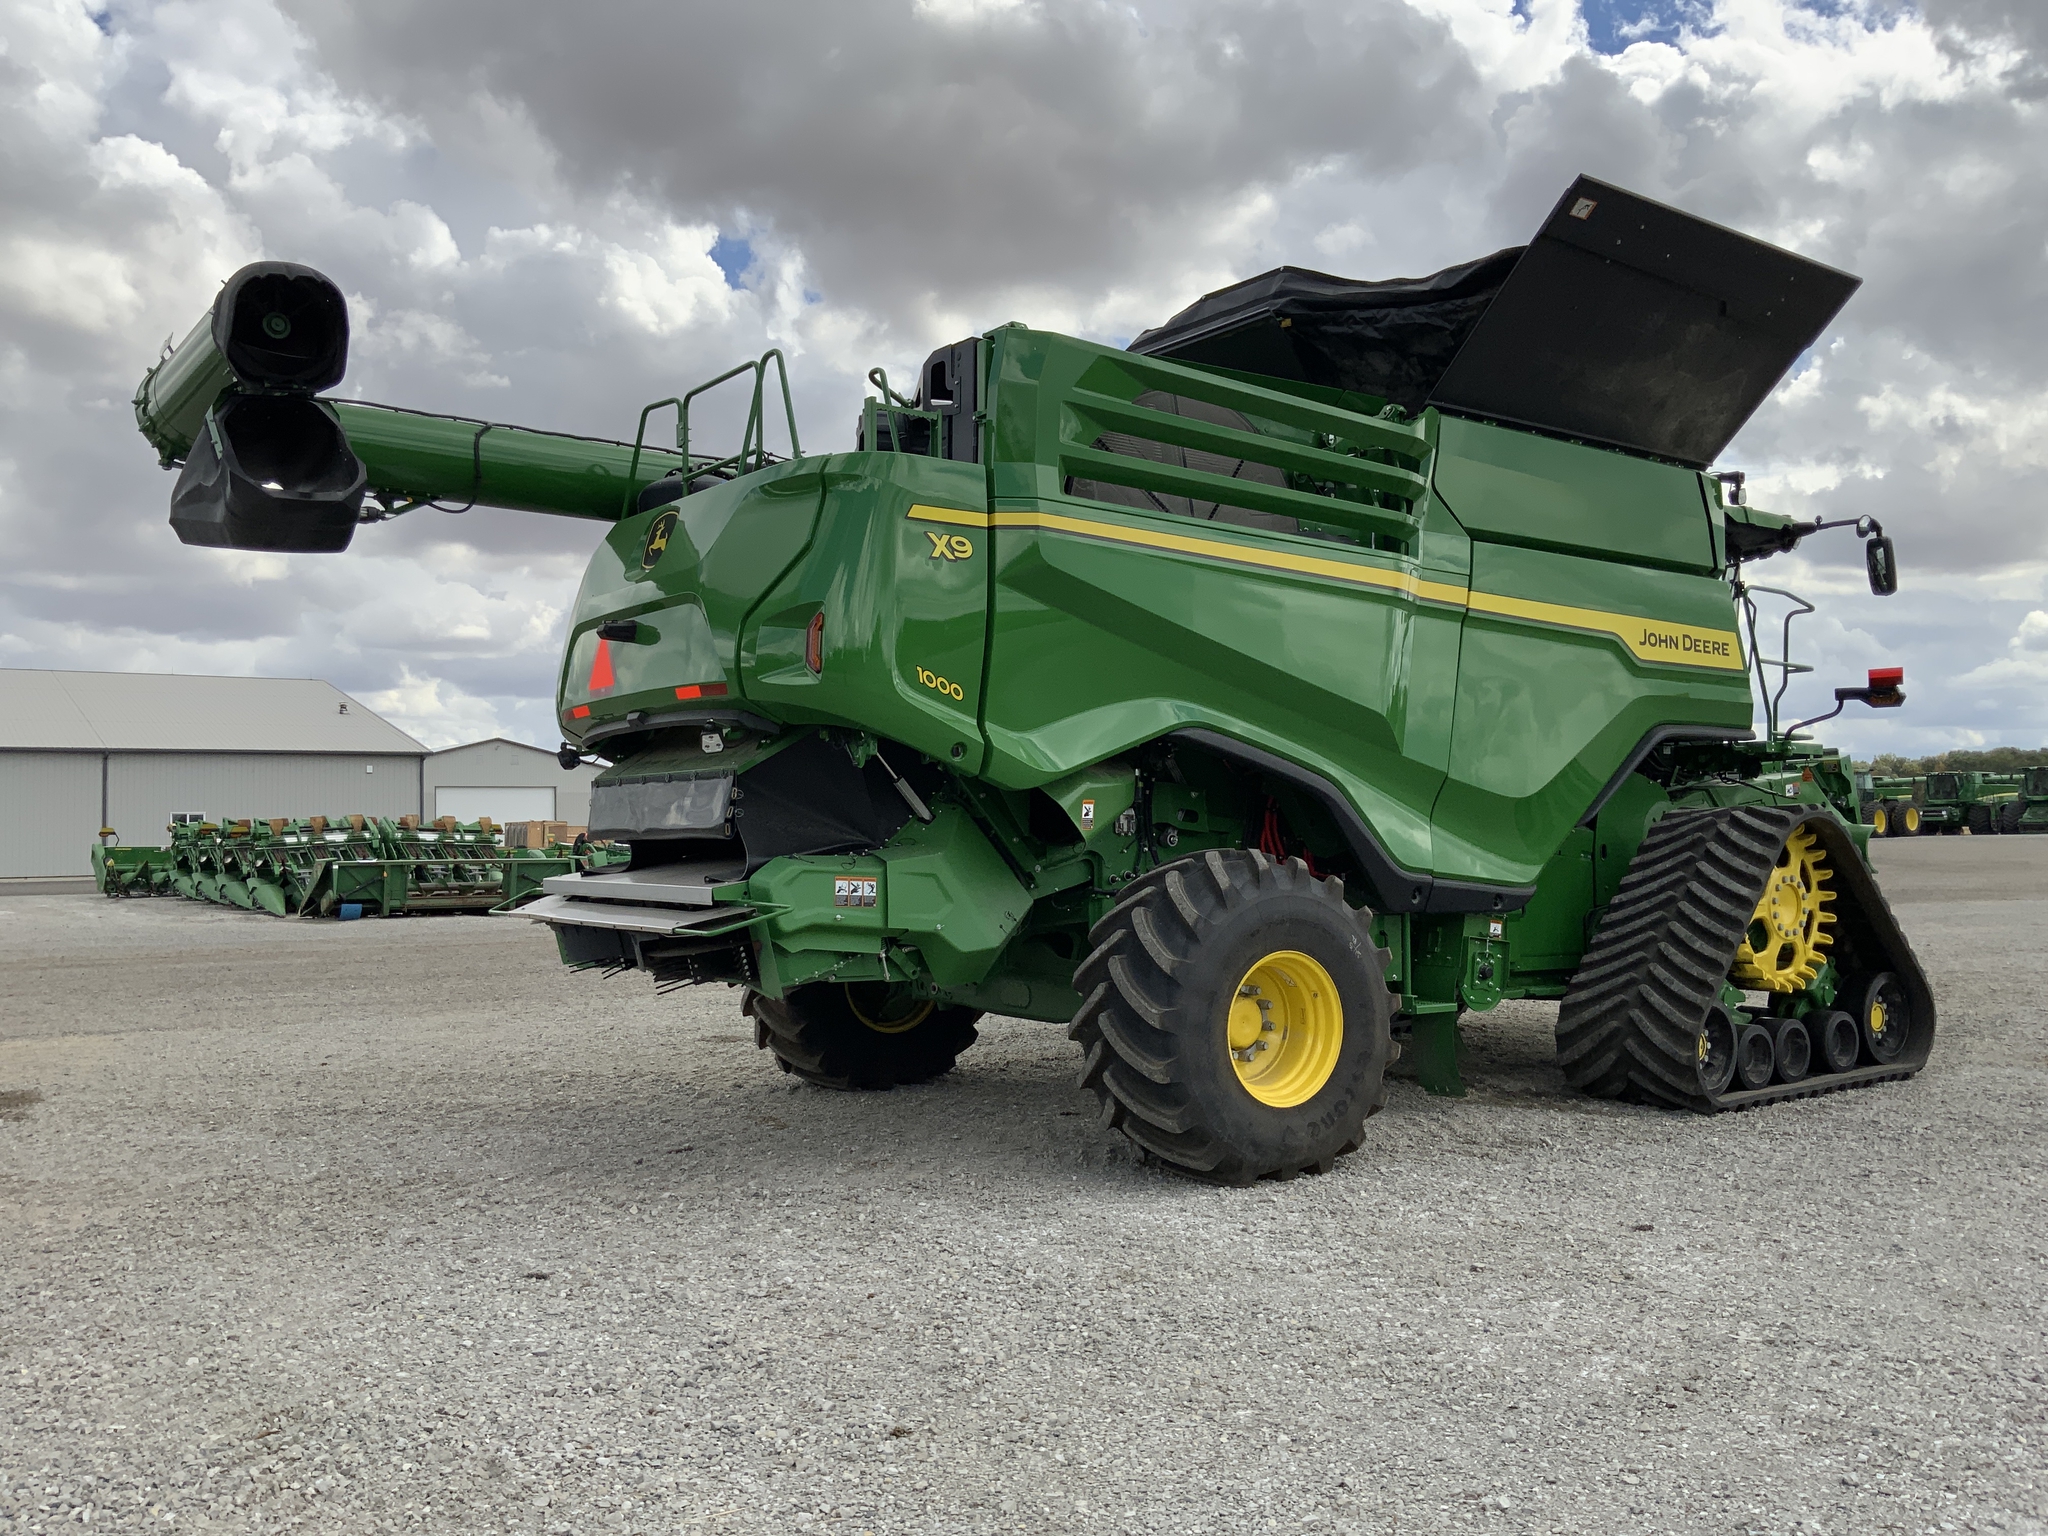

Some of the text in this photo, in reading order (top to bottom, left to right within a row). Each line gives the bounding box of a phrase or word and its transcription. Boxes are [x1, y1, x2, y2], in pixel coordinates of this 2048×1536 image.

[924, 530, 973, 561] X9
[1638, 628, 1729, 656] JOHN DEERE
[916, 665, 964, 701] 1000
